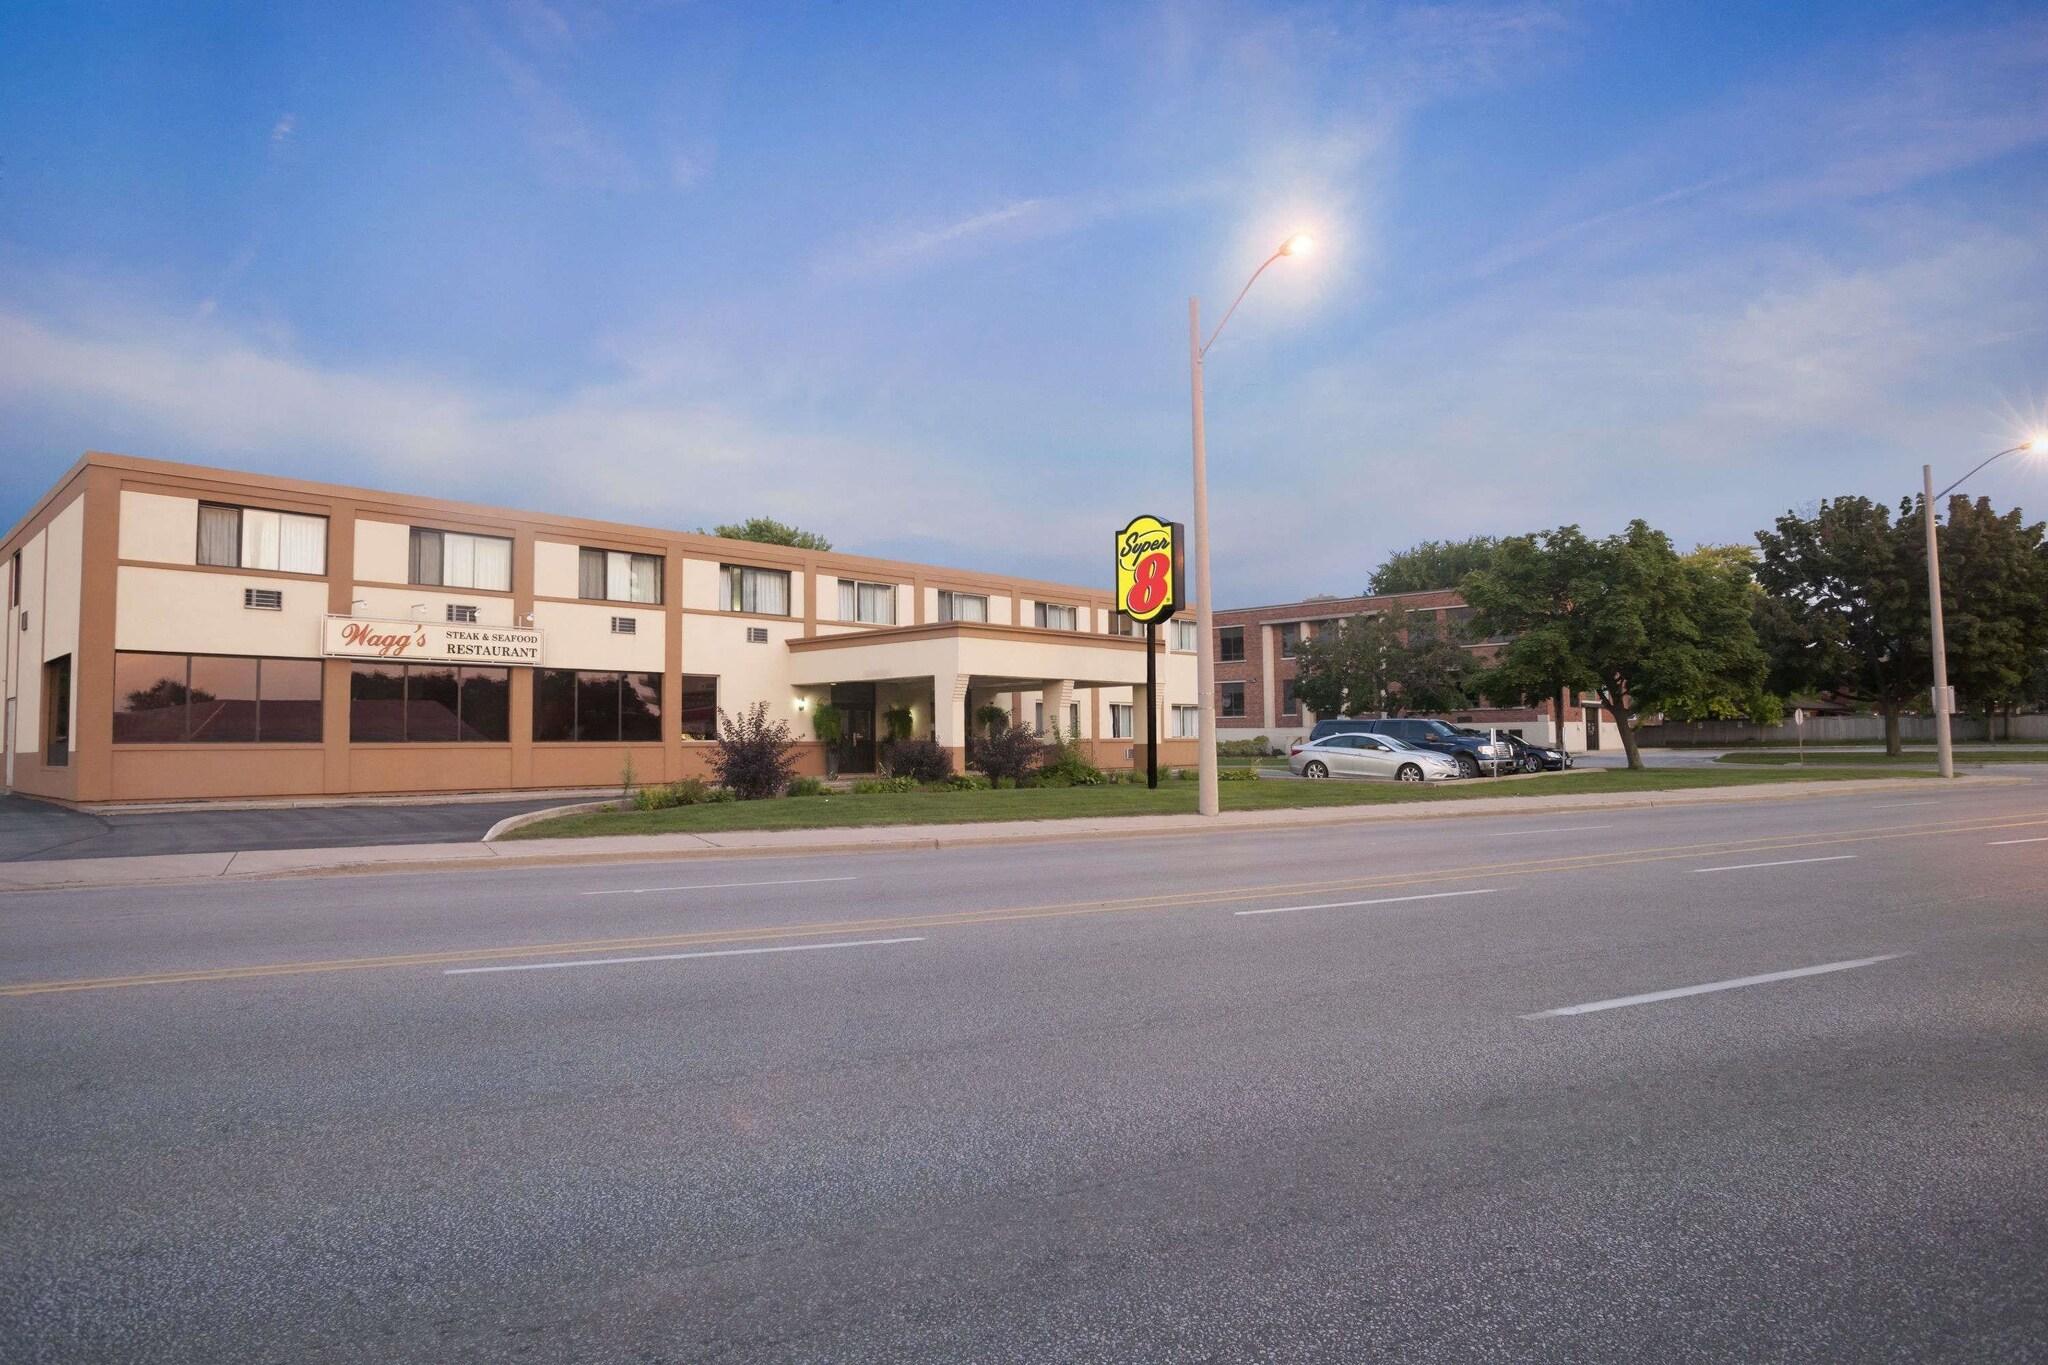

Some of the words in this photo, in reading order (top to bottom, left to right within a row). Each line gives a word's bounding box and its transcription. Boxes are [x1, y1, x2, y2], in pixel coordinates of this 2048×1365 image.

[1120, 531, 1170, 567] Super
[1127, 553, 1170, 613] 8
[341, 623, 426, 656] Wagg's
[446, 631, 479, 641] STEAK
[482, 633, 489, 641] &
[492, 633, 538, 644] SEAFOOD
[447, 643, 538, 658] RESTAURANT
